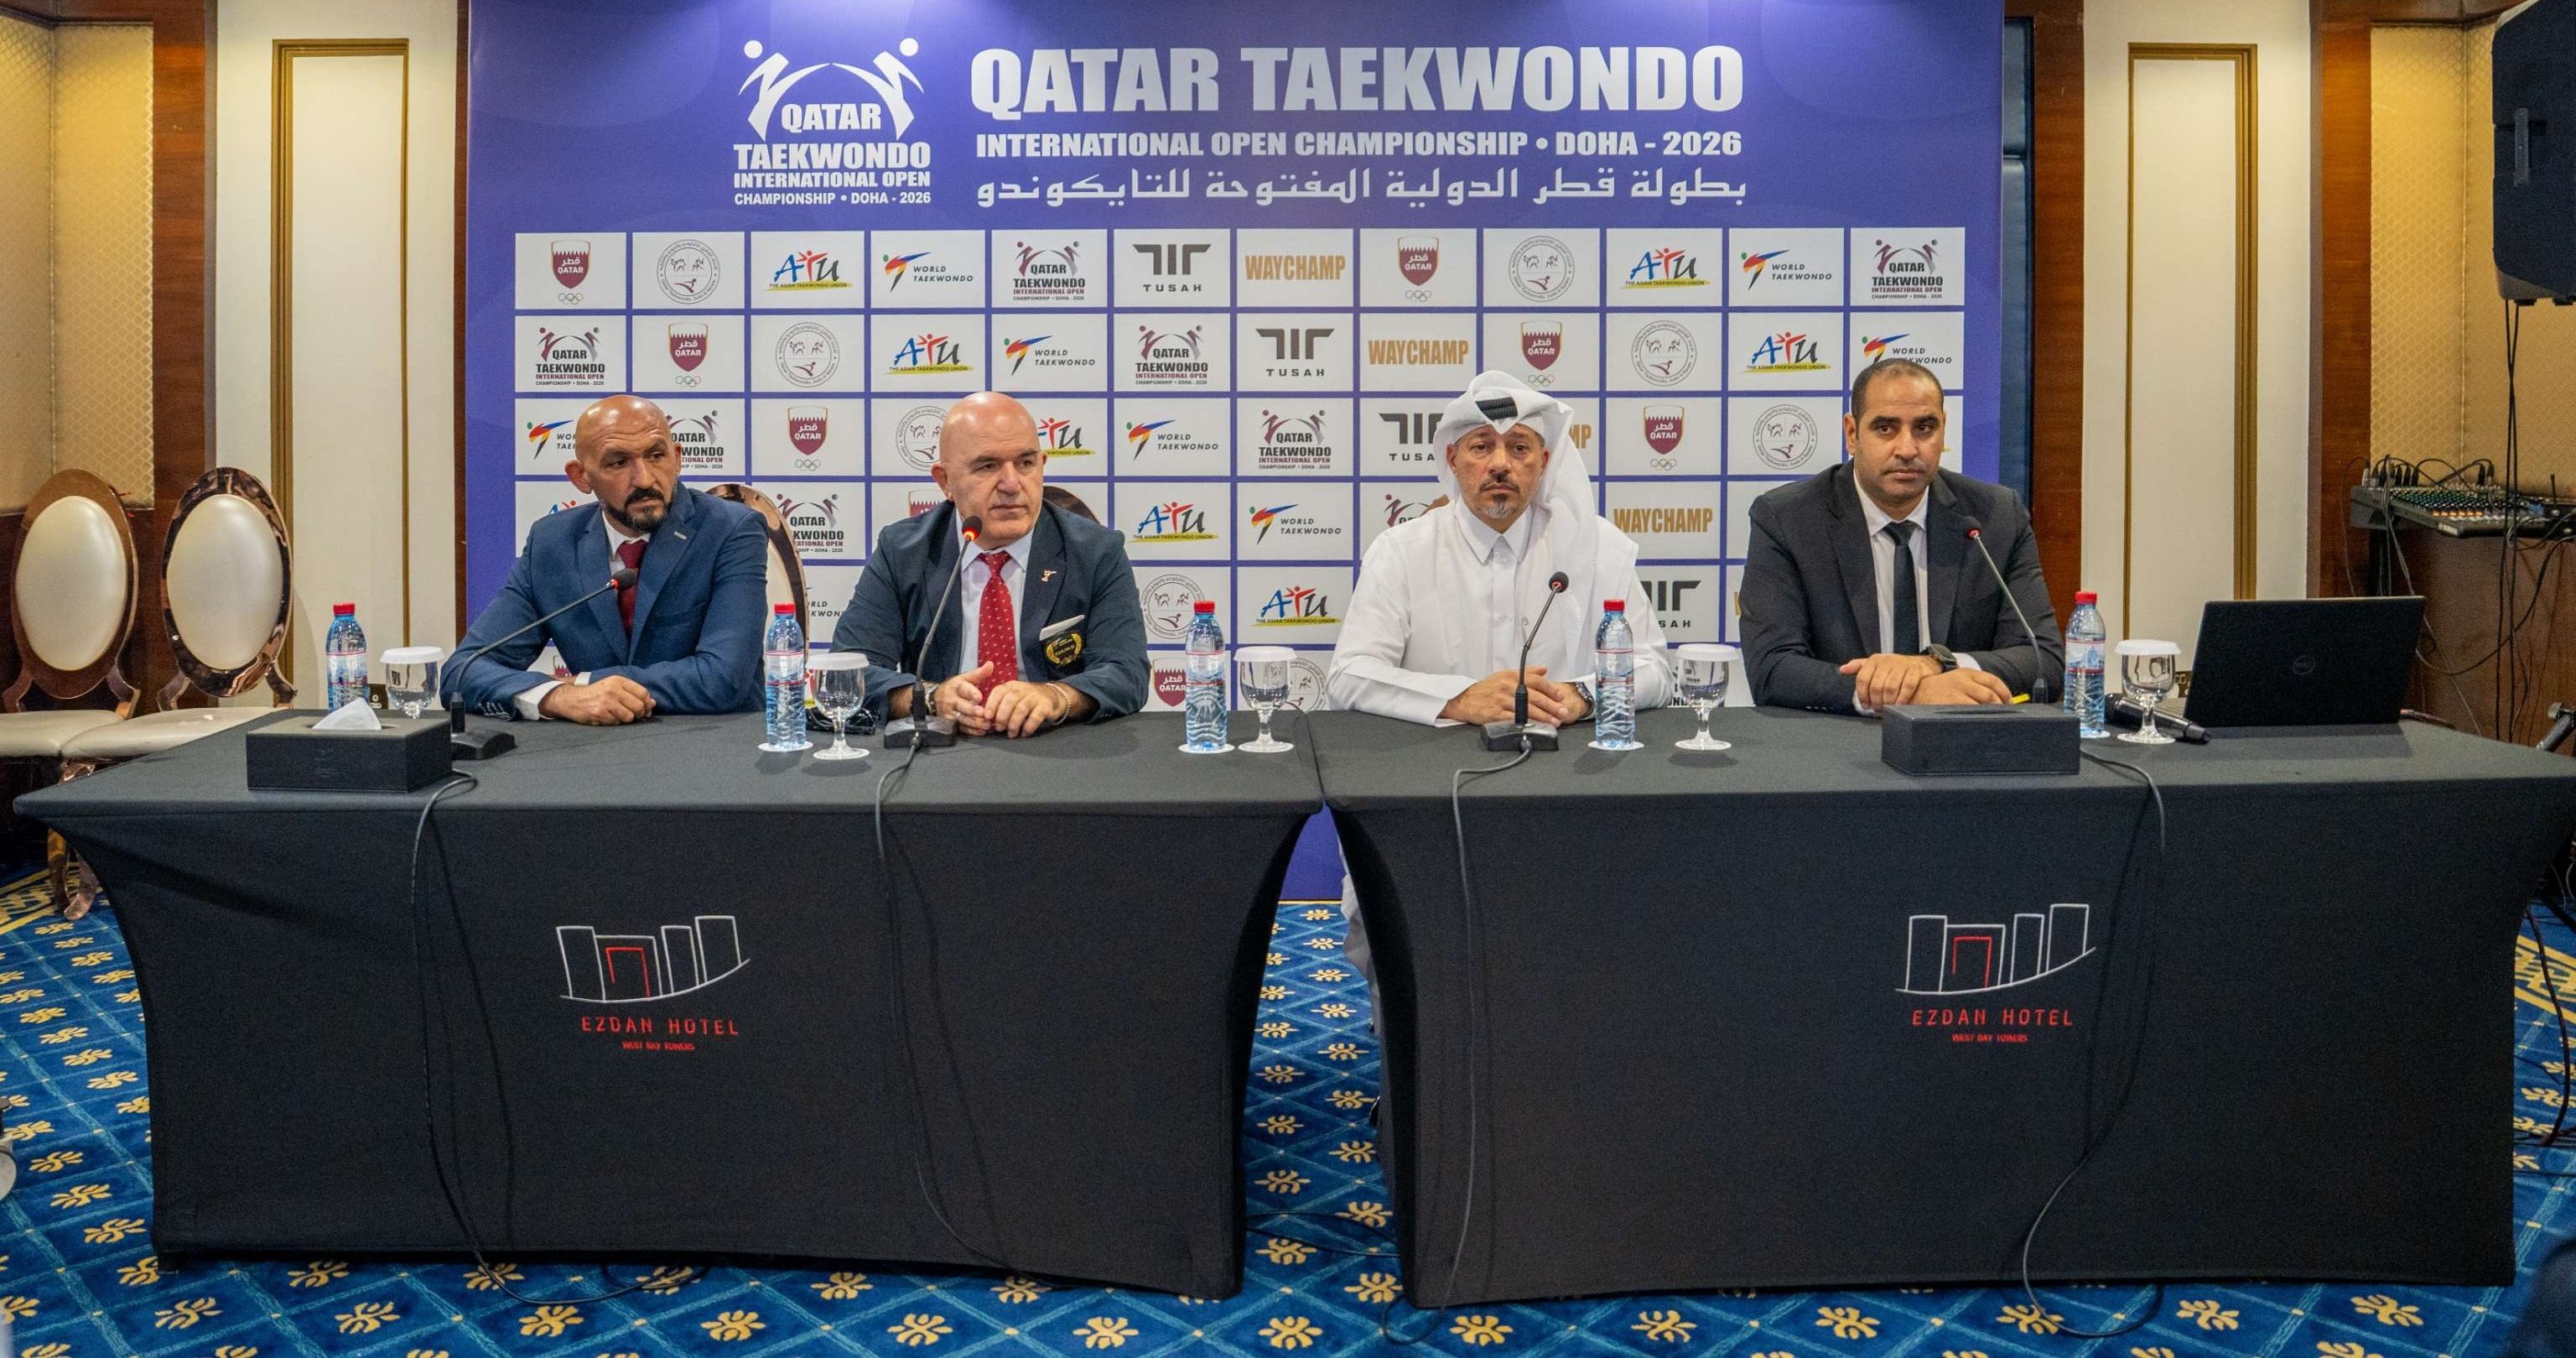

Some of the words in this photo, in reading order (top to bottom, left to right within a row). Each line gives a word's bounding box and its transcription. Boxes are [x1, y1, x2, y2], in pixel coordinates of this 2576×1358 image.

[971, 48, 1219, 120] QATAR
[1240, 45, 1743, 113] TAEKWONDO
[782, 103, 881, 133] QATAR
[977, 133, 1203, 157] INTERNATIONAL
[1211, 132, 1286, 156] OPEN
[1295, 132, 1528, 156] CHAMPIONSHIP
[1555, 132, 1638, 156] DOHA
[1663, 131, 1742, 156] 2026
[734, 142, 931, 169] TAEKWONDO
[734, 172, 880, 189] INTERNATIONAL
[883, 171, 930, 187] OPEN
[978, 169, 1190, 208] للتايكوندو
[1207, 168, 1370, 207] المفتوحة
[1386, 168, 1518, 208] الدولية
[1533, 168, 1615, 204] قطر
[1631, 168, 1746, 206] بطولة
[735, 193, 836, 205] CHAMPIONSHIP
[851, 192, 888, 204] DOHA
[900, 191, 931, 204] 2026
[561, 257, 580, 266] قطر
[1409, 253, 1429, 263] قطر
[1031, 264, 1067, 274] QATAR
[1245, 255, 1346, 280] WAYCHAMP
[1889, 263, 1924, 273] QATAR
[1013, 278, 1085, 288] TAEKWONDO
[1872, 277, 1943, 286] TAEKWONDO
[679, 340, 698, 349] قطر
[1532, 338, 1552, 347] قطر
[553, 350, 587, 360] QATAR
[1154, 348, 1189, 358] QATAR
[1368, 340, 1469, 365] WAYCHAMP
[536, 363, 605, 372] TAEKWONDO
[1135, 362, 1208, 372] TAEKWONDO
[798, 423, 818, 432] قطر
[1654, 422, 1674, 431] قطر
[1276, 433, 1312, 443] QATAR
[682, 446, 724, 456] WONDO
[1259, 446, 1331, 456] TAEKWONDO
[790, 517, 825, 527] QATAR
[1613, 508, 1712, 533] WAYCHAMP
[793, 530, 844, 540] KWONDO
[1658, 620, 1690, 628] SAH
[1912, 1009, 1987, 1026] EZDAN
[2002, 1009, 2073, 1027] HOTEL
[581, 1016, 652, 1033] EZDAN
[668, 1017, 739, 1036] HOTEL
